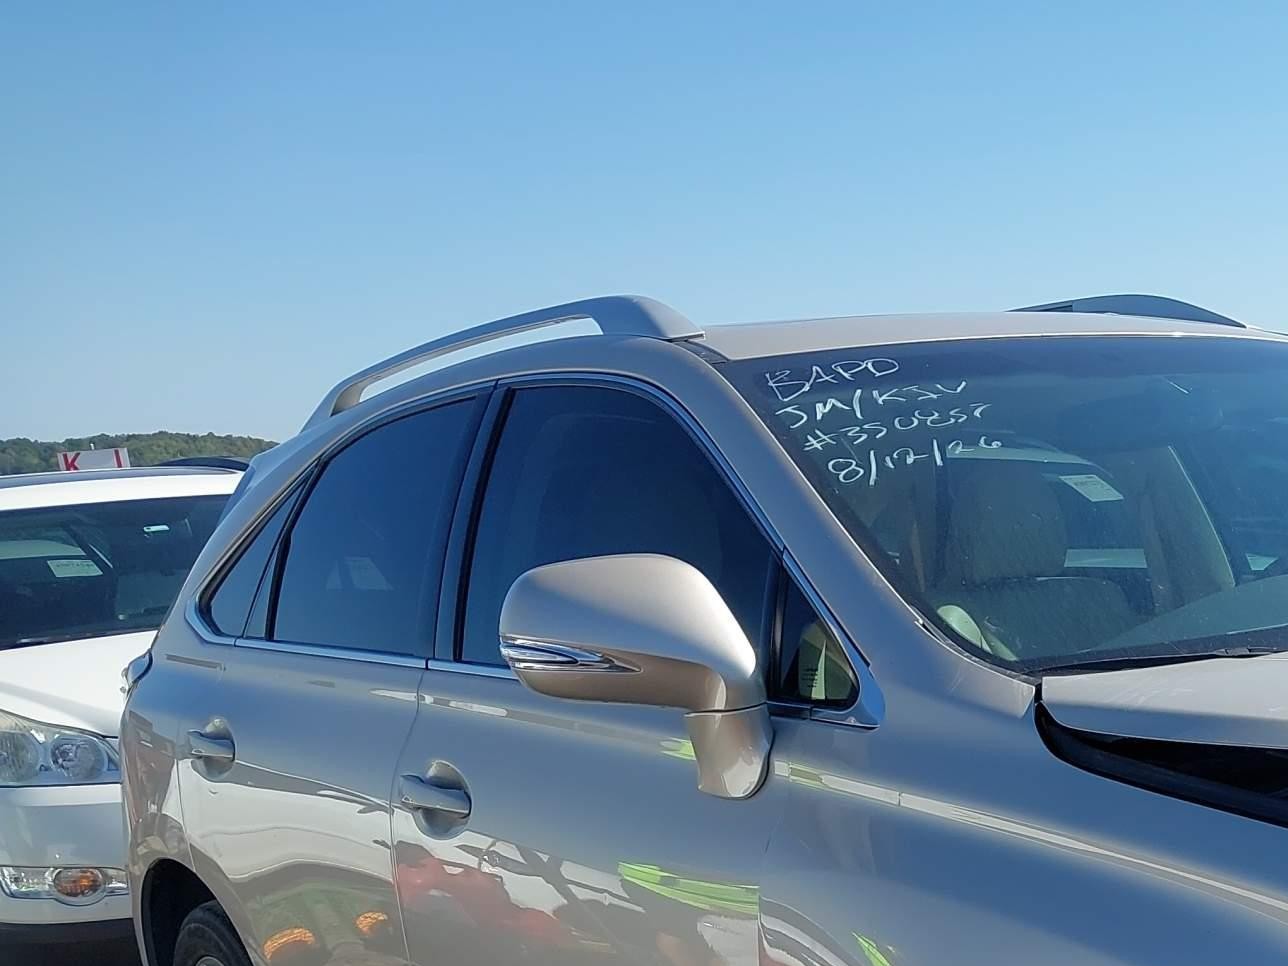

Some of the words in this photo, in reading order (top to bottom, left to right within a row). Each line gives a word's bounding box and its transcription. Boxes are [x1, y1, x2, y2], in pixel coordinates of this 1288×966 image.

[766, 358, 899, 401] BAPD
[62, 452, 81, 472] K
[828, 436, 1002, 486] 8/12/26
